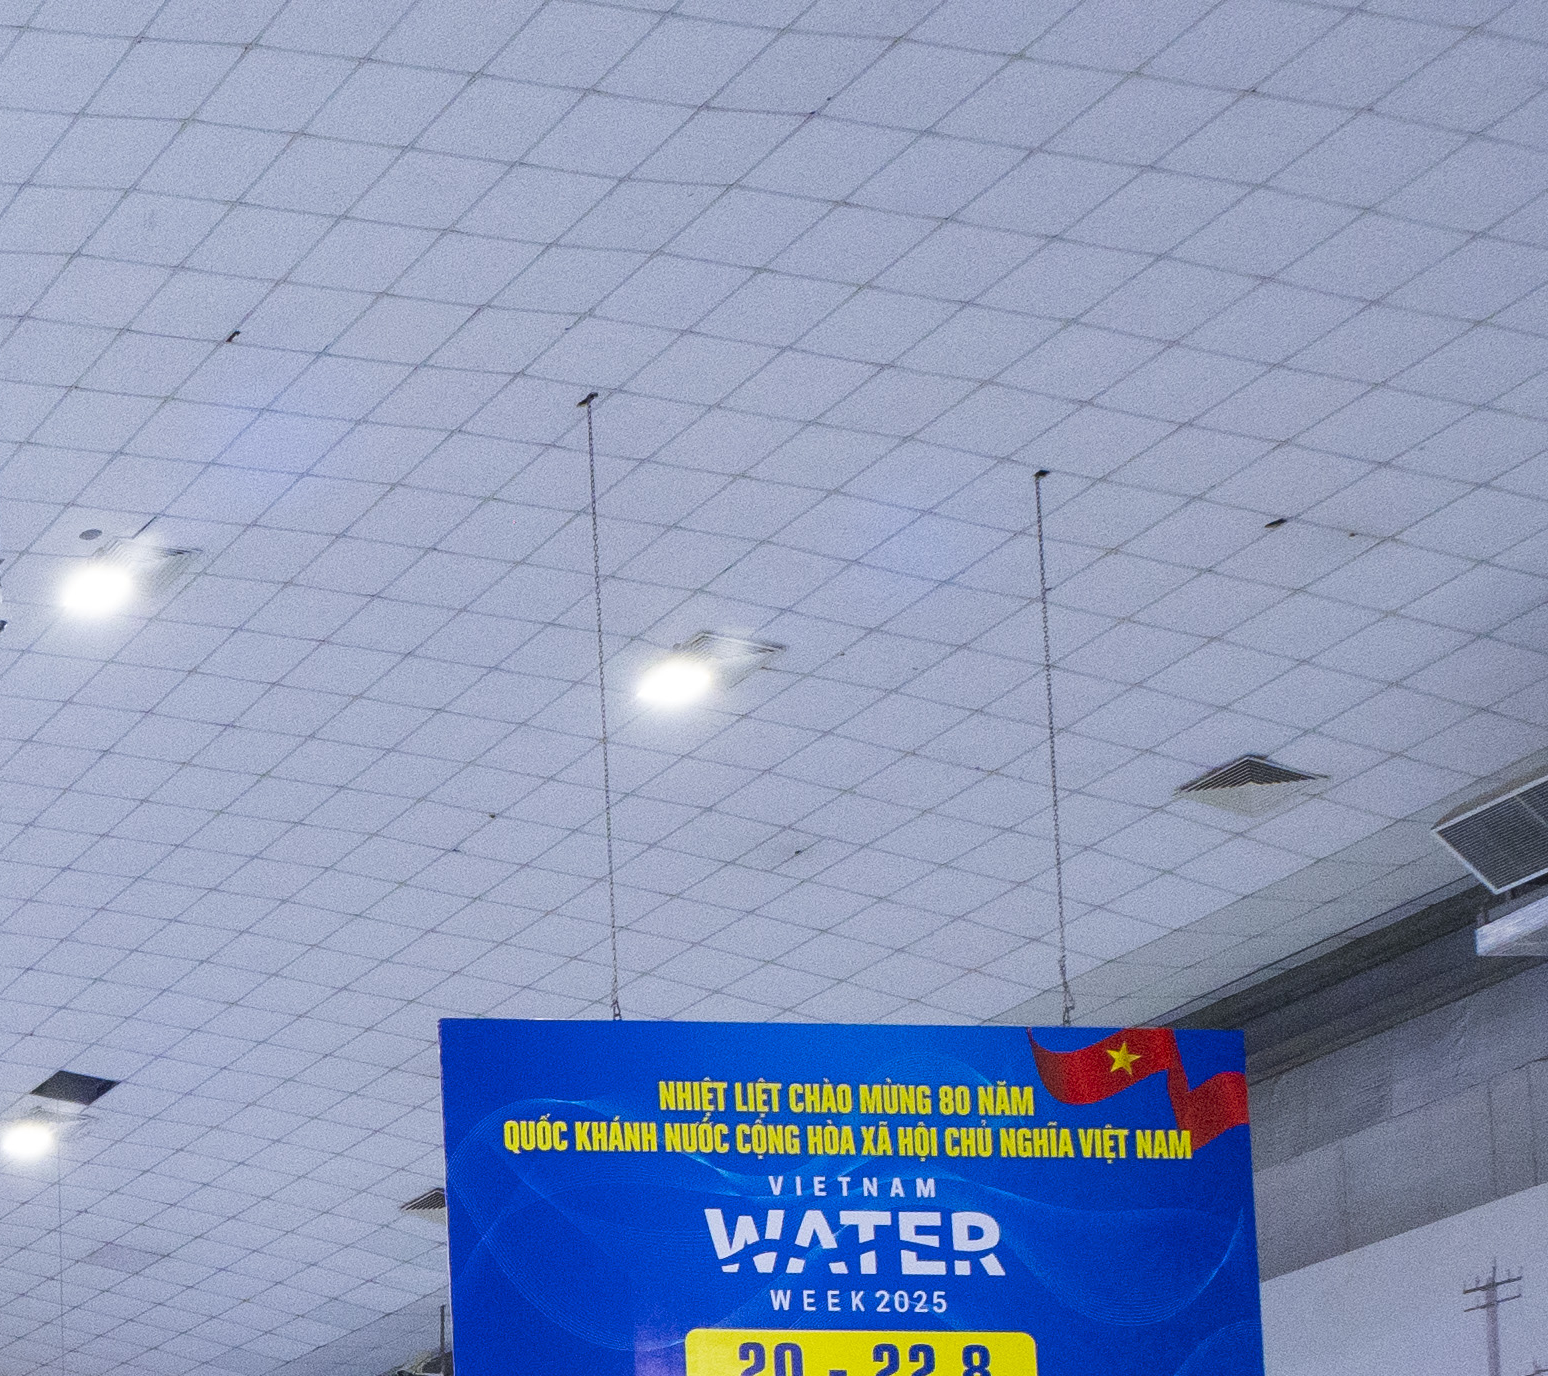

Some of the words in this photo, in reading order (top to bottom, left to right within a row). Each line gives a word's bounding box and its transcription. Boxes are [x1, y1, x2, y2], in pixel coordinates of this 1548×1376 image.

[659, 1077, 727, 1118] NHIỆT
[735, 1078, 782, 1118] LIỆT
[788, 1078, 852, 1113] CHÀO
[939, 1084, 971, 1115] 80
[977, 1081, 1034, 1116] NĂM
[503, 1113, 568, 1154] QUỐC
[575, 1116, 658, 1152] KHÁNH
[665, 1112, 729, 1153] NƯỚC
[736, 1119, 800, 1160] CỘNG
[808, 1119, 855, 1155] HÒA
[861, 1121, 892, 1156] XÃ
[898, 1121, 938, 1161] HỘI
[945, 1120, 993, 1157] CHỦ
[1000, 1121, 1075, 1158] NGHĨA
[1078, 1124, 1129, 1164] VIỆT
[1136, 1129, 1192, 1159] NAM
[768, 1174, 936, 1199] VIETNAM
[704, 1206, 1006, 1275] WATER
